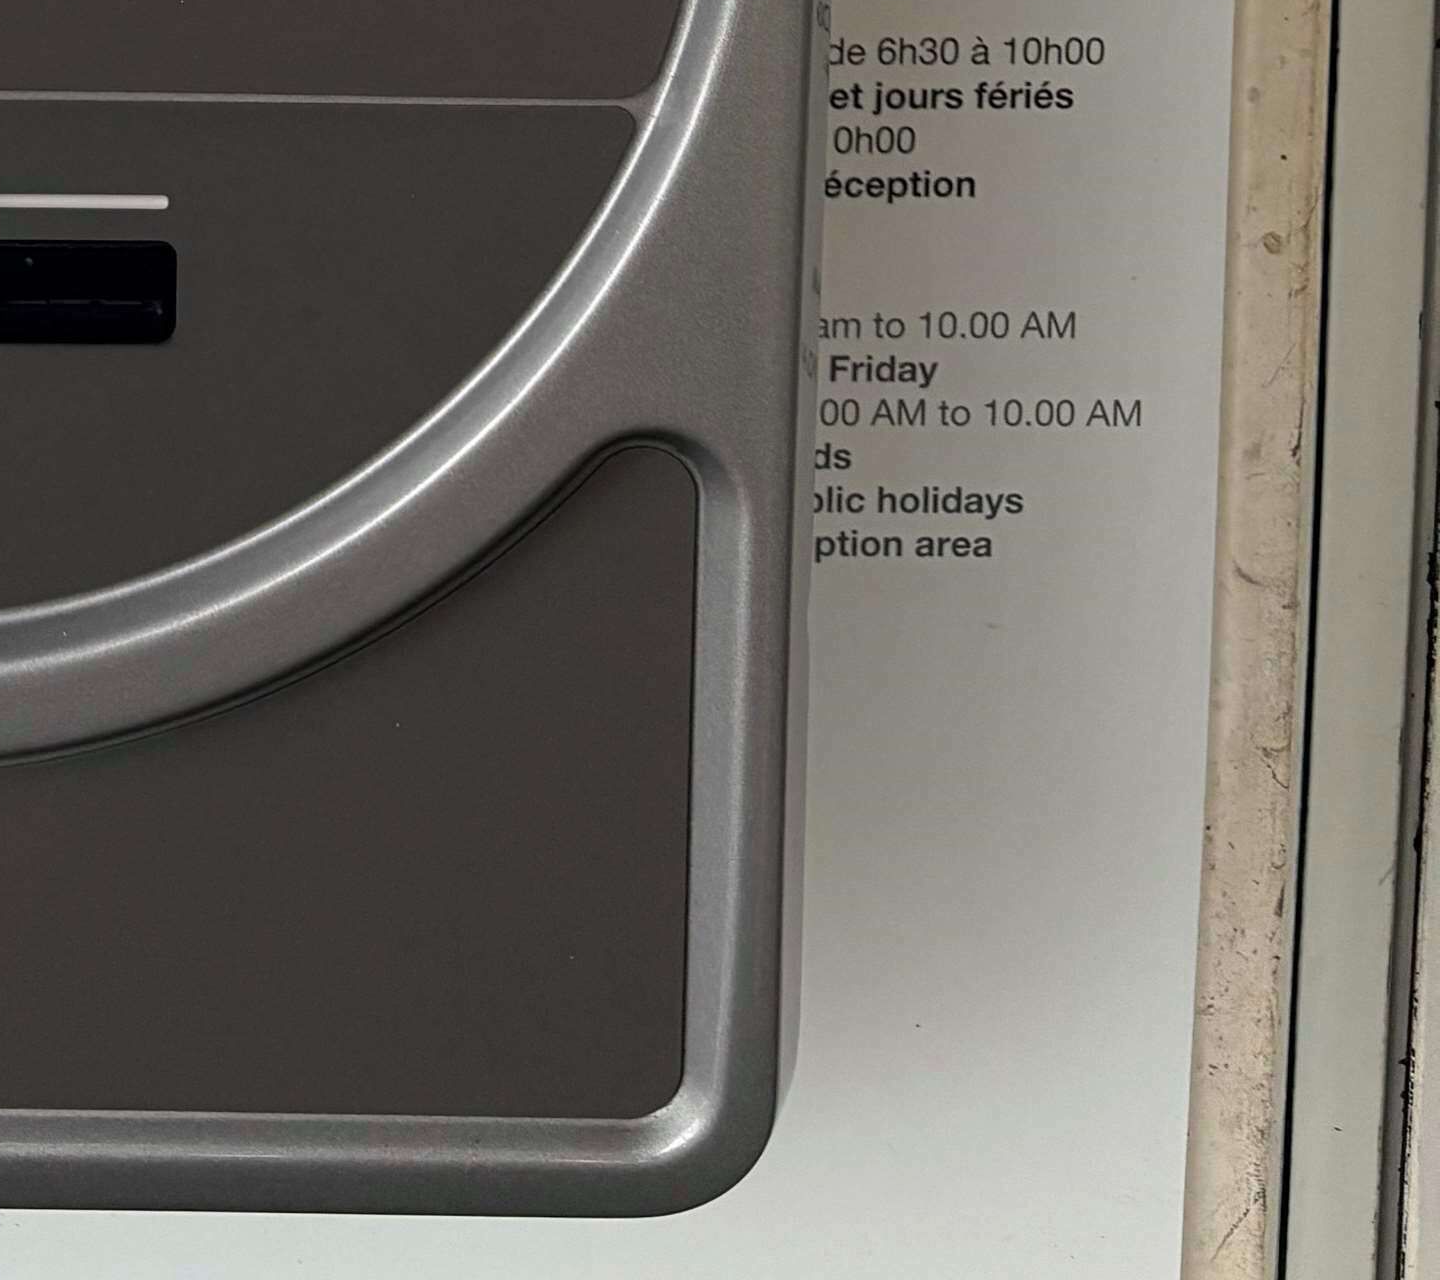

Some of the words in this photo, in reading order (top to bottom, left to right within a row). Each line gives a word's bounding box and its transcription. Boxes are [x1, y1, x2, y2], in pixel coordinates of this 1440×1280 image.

[829, 38, 866, 65] de
[878, 37, 959, 65] 6h30
[971, 36, 990, 65] à
[1004, 37, 1104, 65] 10h00
[830, 84, 862, 109] et
[873, 82, 963, 115] jours
[974, 81, 1073, 109] fériés
[874, 313, 905, 338] to
[920, 312, 1009, 339] 10.00
[1020, 311, 1075, 338] AM
[830, 355, 938, 388] Friday
[871, 399, 925, 426] AM
[939, 401, 970, 426] to
[985, 399, 1075, 427] 10.00
[1086, 400, 1141, 426] AM
[878, 486, 1023, 520] holidays
[916, 537, 992, 557] area
